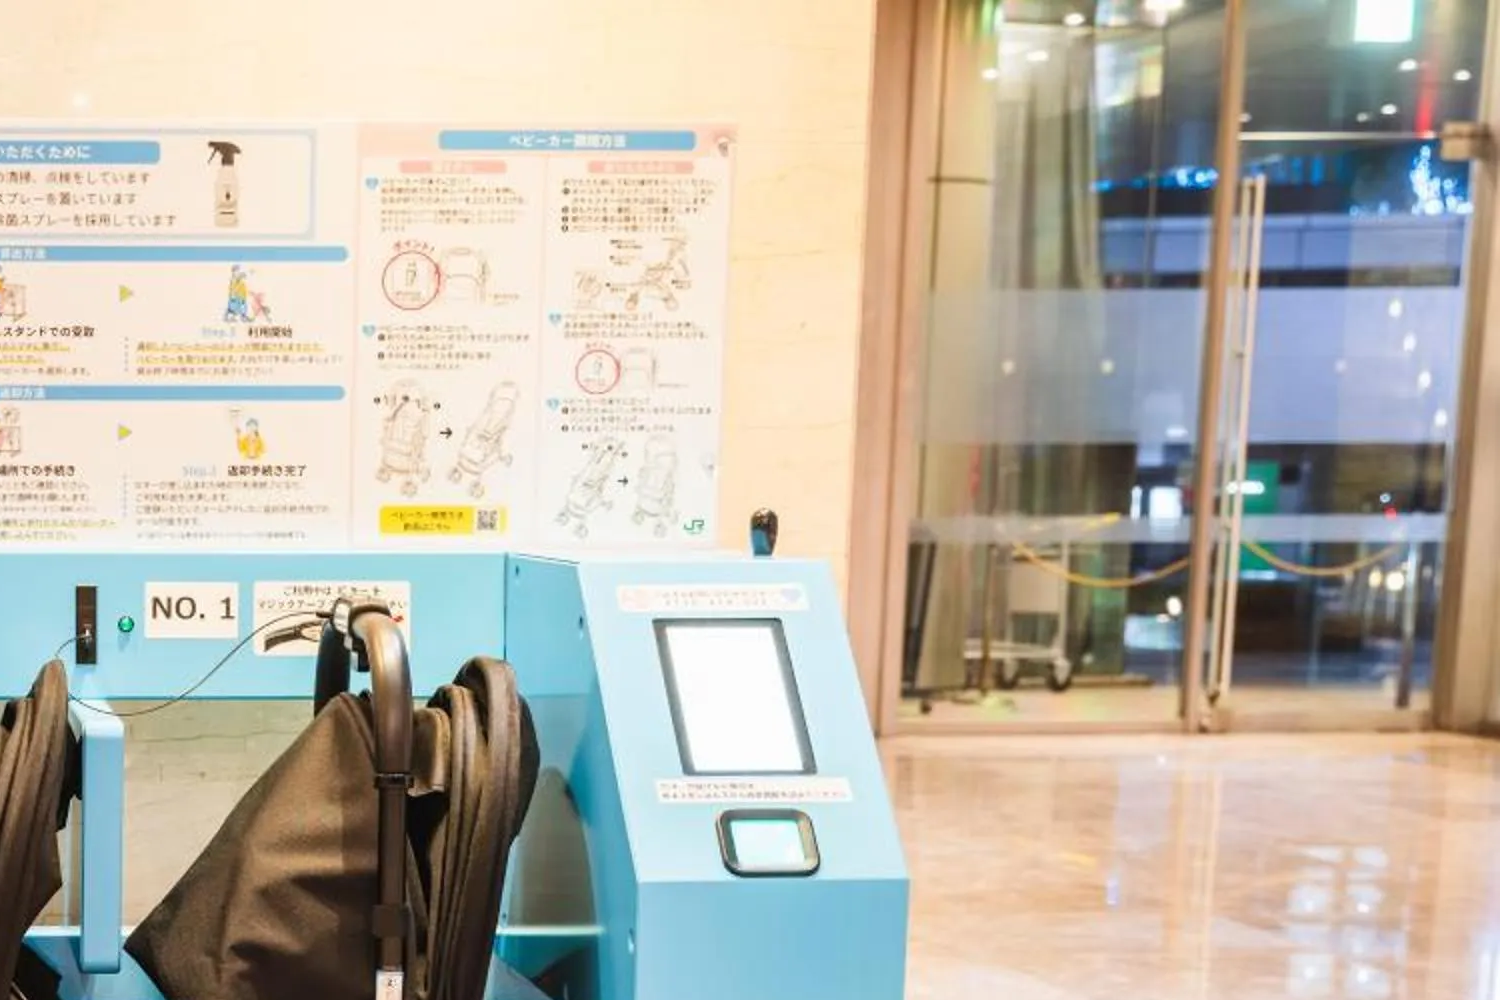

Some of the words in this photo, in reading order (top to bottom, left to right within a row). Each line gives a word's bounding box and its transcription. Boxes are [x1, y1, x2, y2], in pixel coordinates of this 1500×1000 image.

[227, 464, 307, 477] 返却手続き完了
[683, 518, 705, 533] JR
[151, 596, 205, 620] NO.
[220, 596, 236, 620] 1
